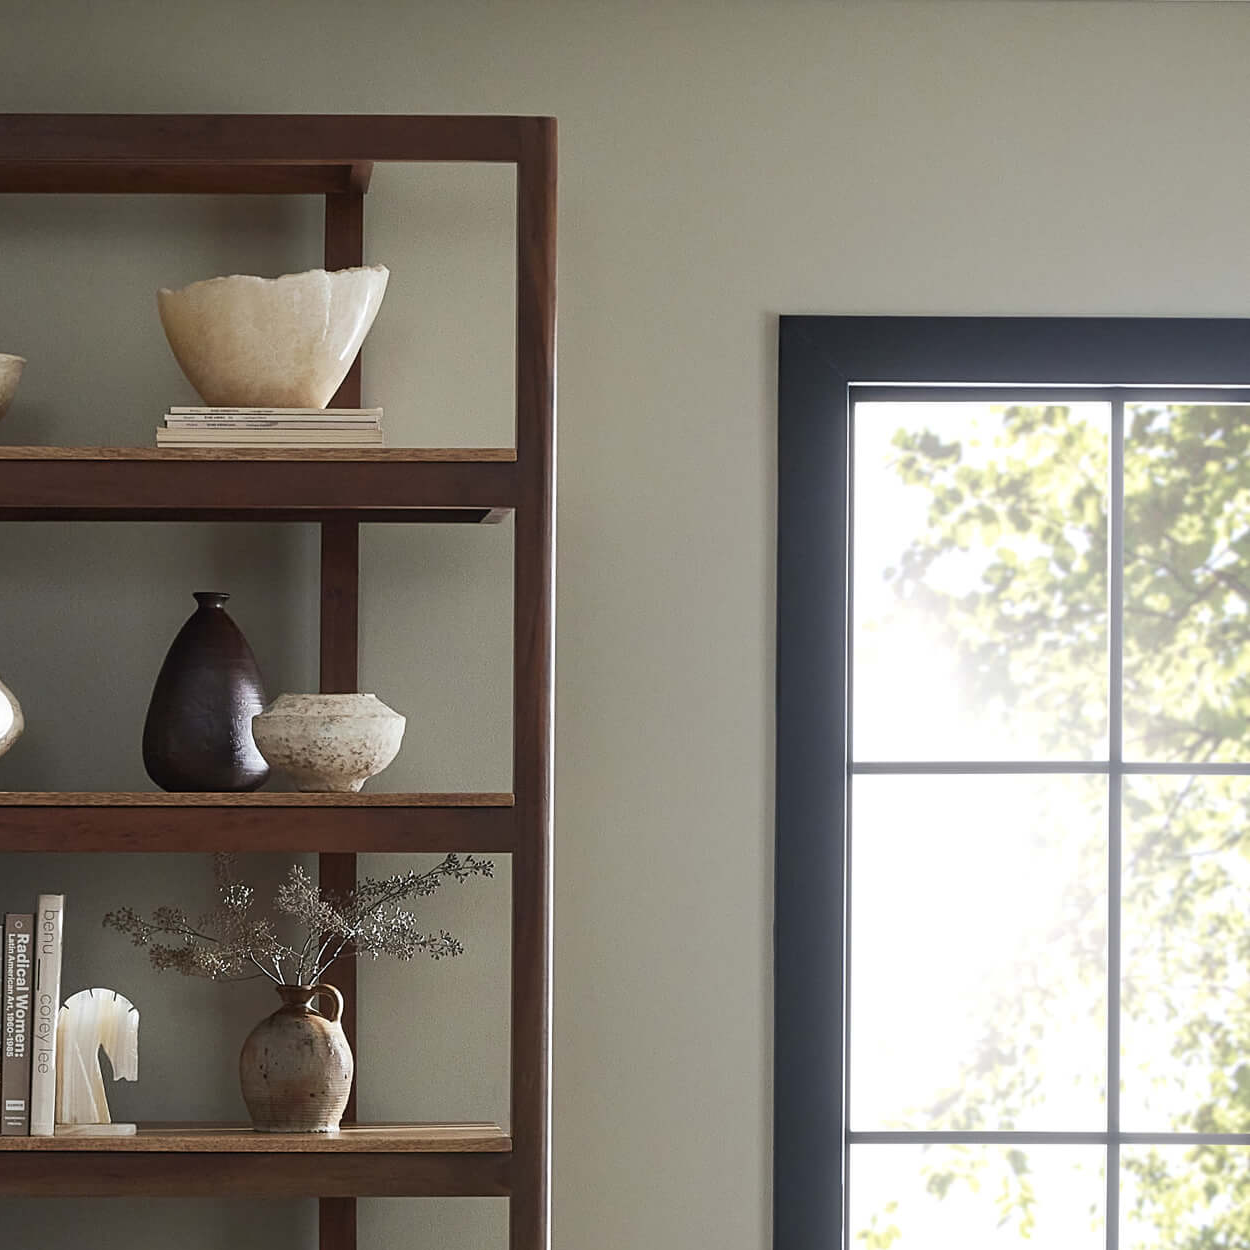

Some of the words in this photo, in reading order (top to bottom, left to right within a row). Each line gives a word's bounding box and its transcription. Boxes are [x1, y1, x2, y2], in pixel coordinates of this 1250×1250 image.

[42, 910, 59, 954] benu
[16, 934, 29, 996] Radical
[16, 997, 29, 1058] Women:
[36, 994, 54, 1042] corey
[38, 1049, 52, 1073] lee
